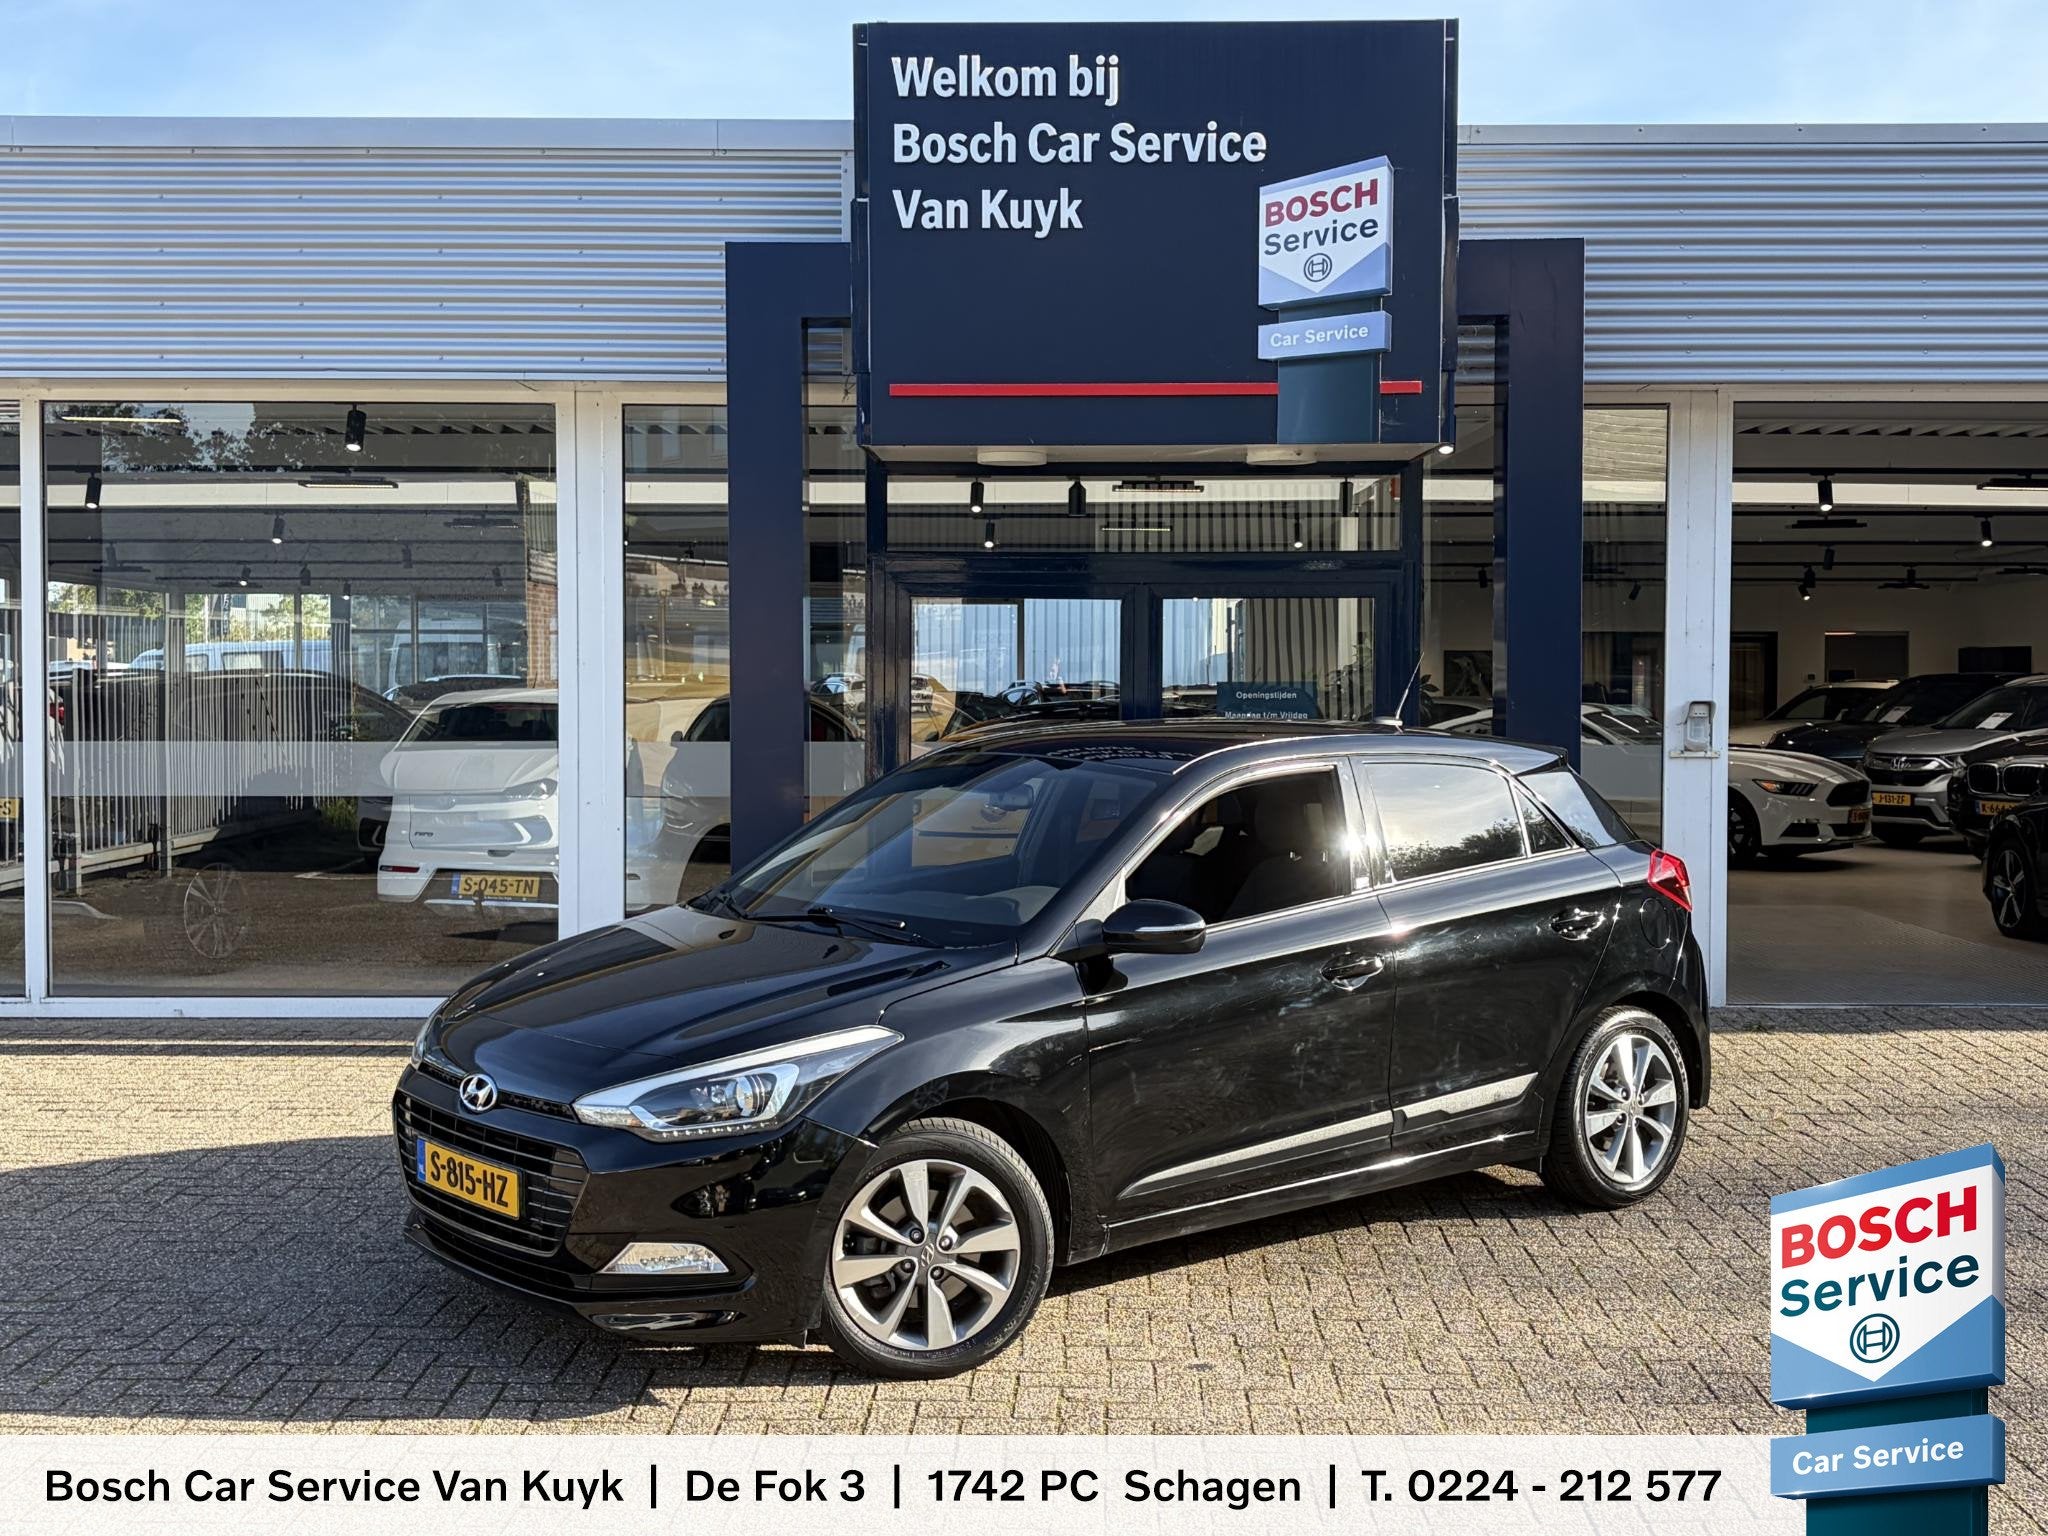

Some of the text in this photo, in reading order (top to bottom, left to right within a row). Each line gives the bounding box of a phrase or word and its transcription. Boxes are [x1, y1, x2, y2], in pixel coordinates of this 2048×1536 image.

[891, 55, 1119, 106] Welkom bij
[893, 121, 1267, 163] Bosch Car Service
[891, 188, 1084, 239] Van Kuyk
[1265, 178, 1378, 227] BOSCH
[1264, 218, 1379, 256] Service
[1270, 325, 1369, 348] Car Service
[1236, 690, 1297, 701] Openingstijden
[463, 876, 534, 895] S-045-TN
[430, 1150, 509, 1208] S-815-HZ
